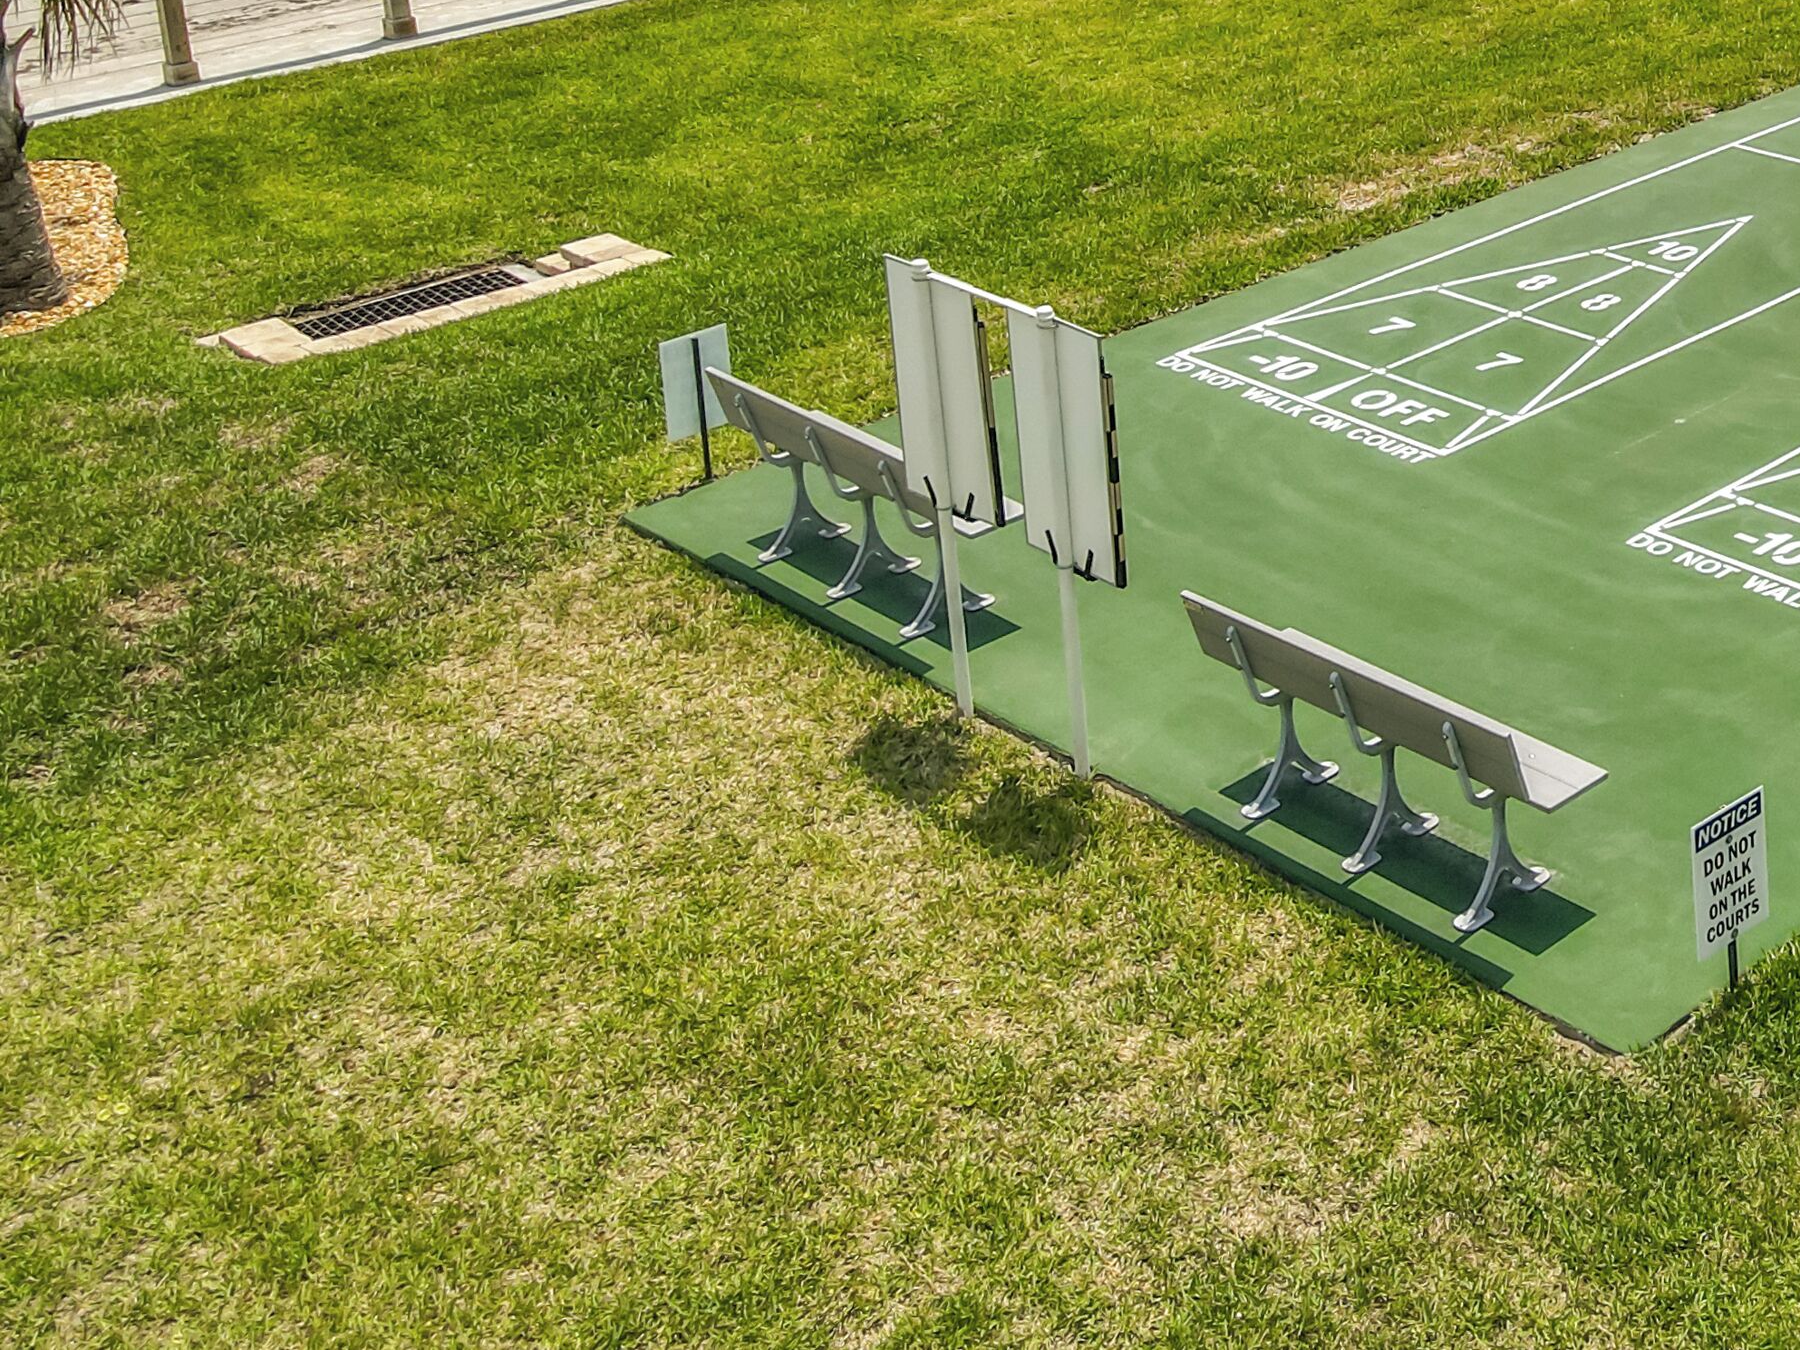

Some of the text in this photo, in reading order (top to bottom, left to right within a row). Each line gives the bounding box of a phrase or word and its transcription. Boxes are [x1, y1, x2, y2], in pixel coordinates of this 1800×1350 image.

[1647, 240, 1699, 262] 10
[1516, 274, 1558, 291] 8
[1580, 293, 1622, 311] 8
[1368, 316, 1417, 335] 7
[1248, 354, 1319, 381] -10
[1475, 351, 1524, 371] 7
[1156, 356, 1437, 464] DO NOT WALK ON COURT
[1350, 389, 1451, 426] OFF
[1625, 532, 1674, 556] DO
[1672, 550, 1742, 580] NOT
[1698, 796, 1759, 848] NOTICE
[1704, 830, 1757, 877] DO NOT
[1710, 858, 1752, 896] WALK
[1709, 878, 1755, 920] ON THE
[1707, 898, 1759, 943] COURTS
